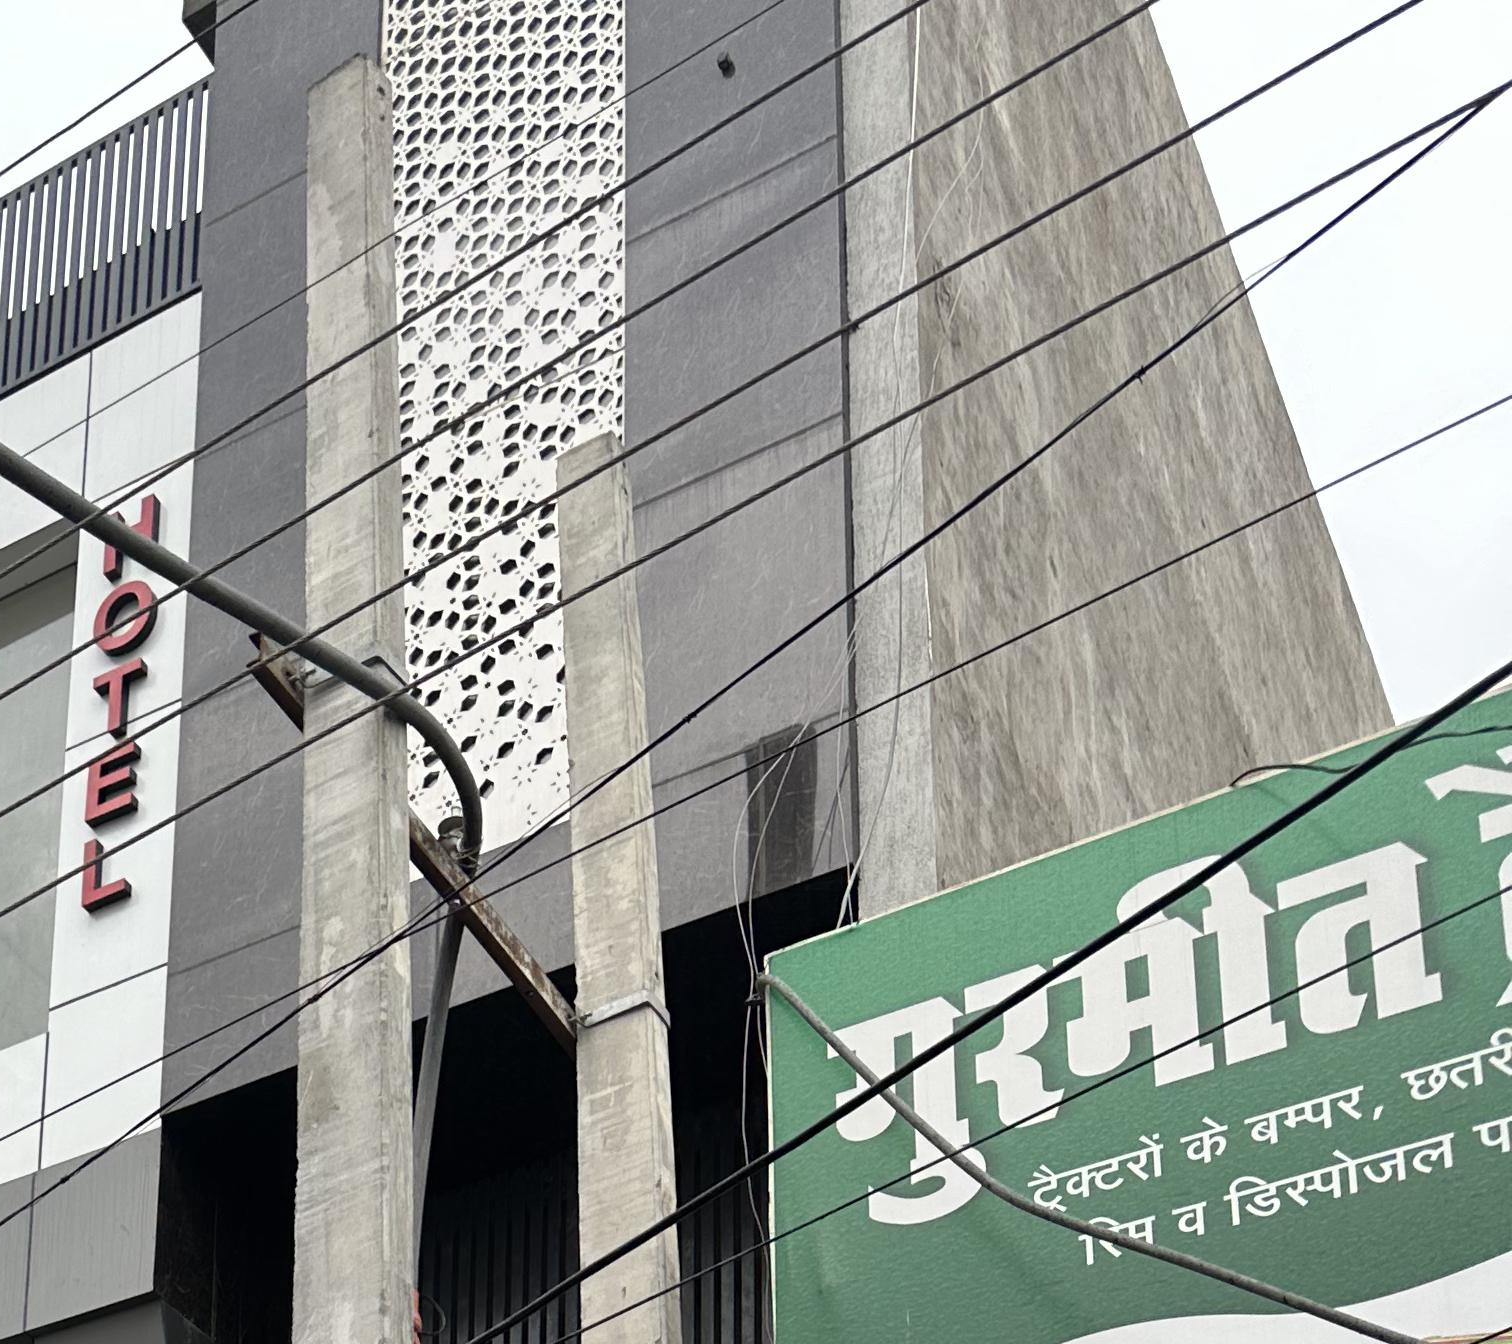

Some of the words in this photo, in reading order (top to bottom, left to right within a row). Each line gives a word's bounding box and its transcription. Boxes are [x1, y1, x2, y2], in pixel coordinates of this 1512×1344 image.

[81, 493, 161, 914] HOTEL
[827, 842, 1445, 1225] गुरमीत
[1178, 1117, 1228, 1163] के
[1244, 1083, 1385, 1148] बम्पर,
[1176, 1199, 1208, 1237] व
[1222, 1130, 1457, 1227] डिस्पोजल
